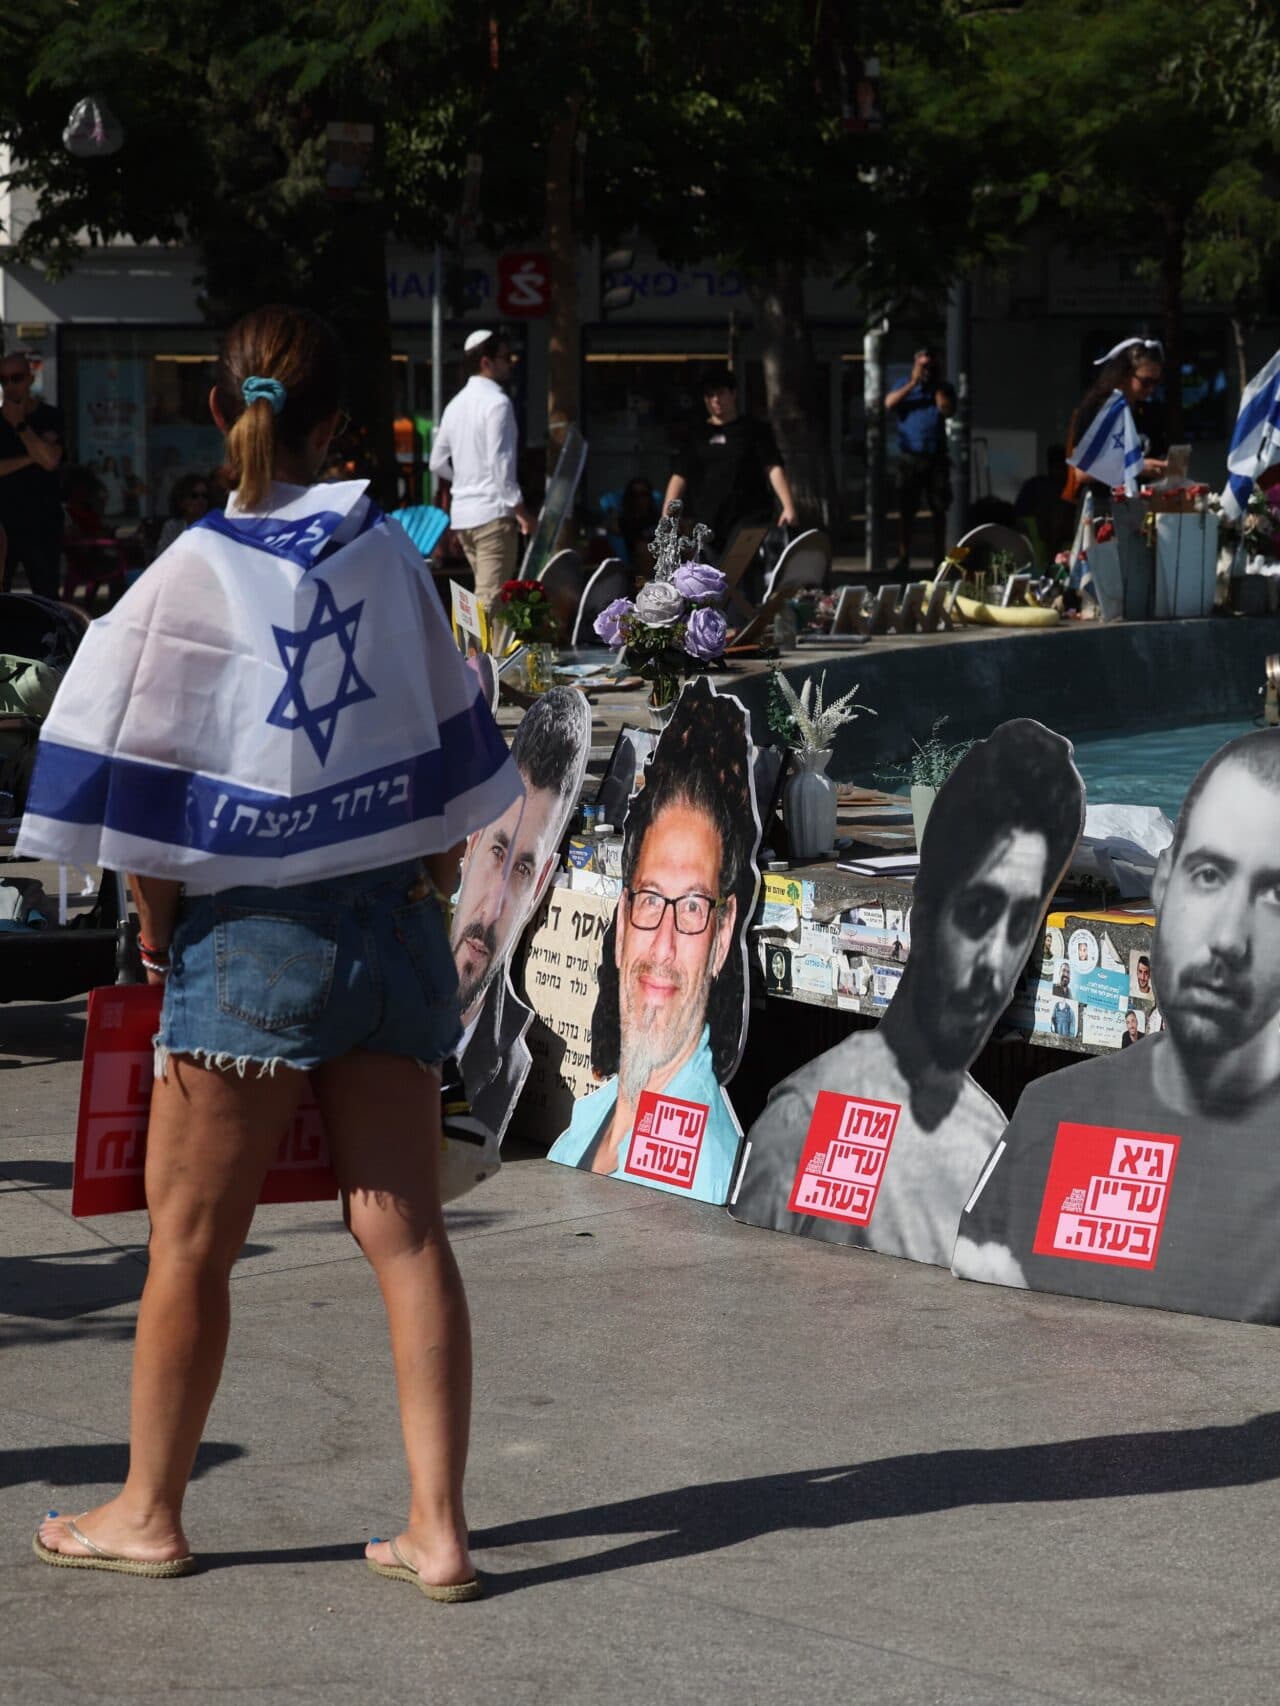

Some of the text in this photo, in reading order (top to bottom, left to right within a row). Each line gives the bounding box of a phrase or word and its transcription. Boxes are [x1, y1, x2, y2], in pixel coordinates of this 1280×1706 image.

[208, 774, 410, 839] ביחד ננצח!
[571, 909, 610, 940] אסף
[566, 954, 588, 972] מרים
[535, 970, 588, 996] נולד בחיפה
[654, 1105, 702, 1138] עדיין
[844, 1107, 892, 1140] מתן
[636, 1142, 692, 1178] בעזה.
[826, 1143, 882, 1176] עדיין
[1118, 1144, 1164, 1178] גיא
[804, 1179, 871, 1214] בעזה.
[1090, 1179, 1161, 1213] עדיין
[1065, 1219, 1151, 1255] בעזה.
